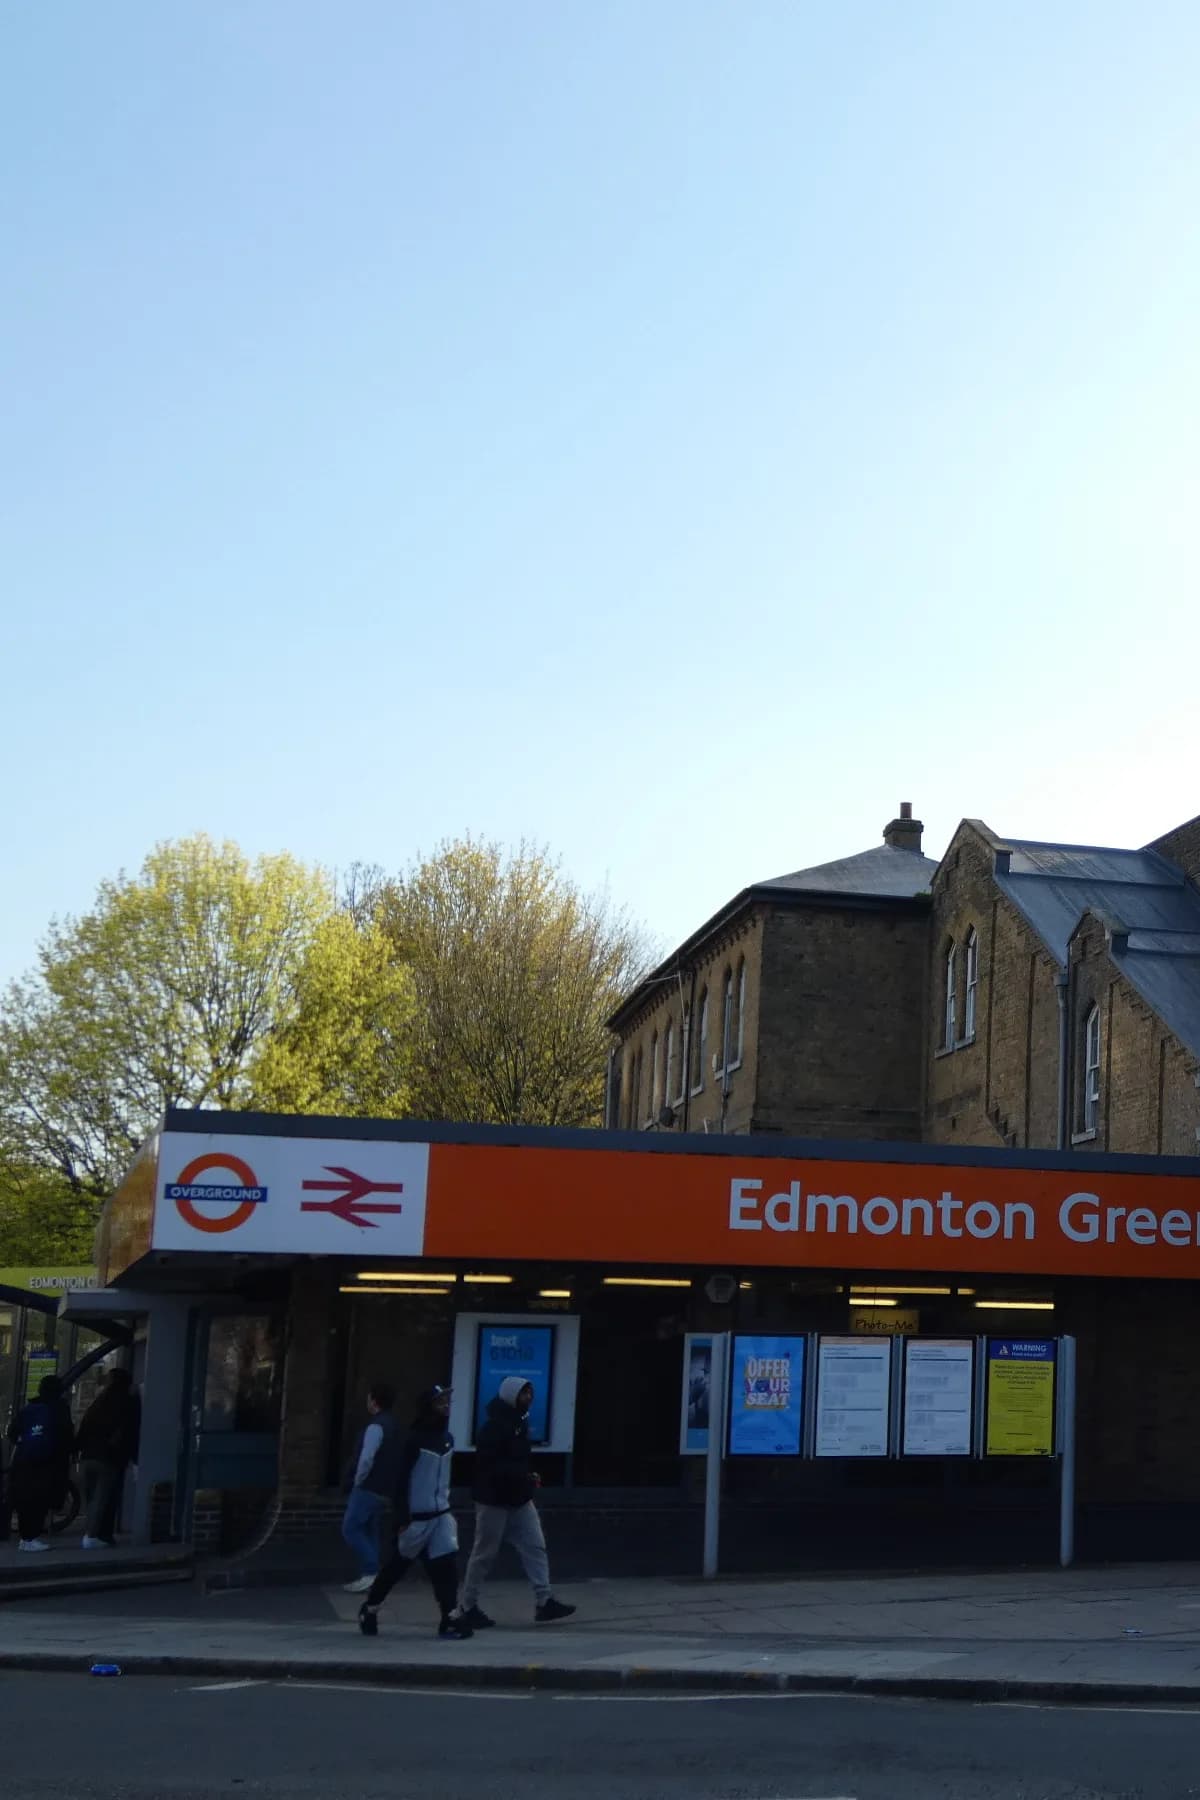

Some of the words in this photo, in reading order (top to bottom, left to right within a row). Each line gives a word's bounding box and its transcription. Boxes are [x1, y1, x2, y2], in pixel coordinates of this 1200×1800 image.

[169, 1185, 264, 1201] OVERGROUND
[728, 1177, 1035, 1240] Edmonton
[30, 1277, 85, 1289] EDMONTON
[1012, 1343, 1047, 1353] WARNING
[747, 1358, 791, 1377] OFFER
[746, 1392, 790, 1406] SEAT
